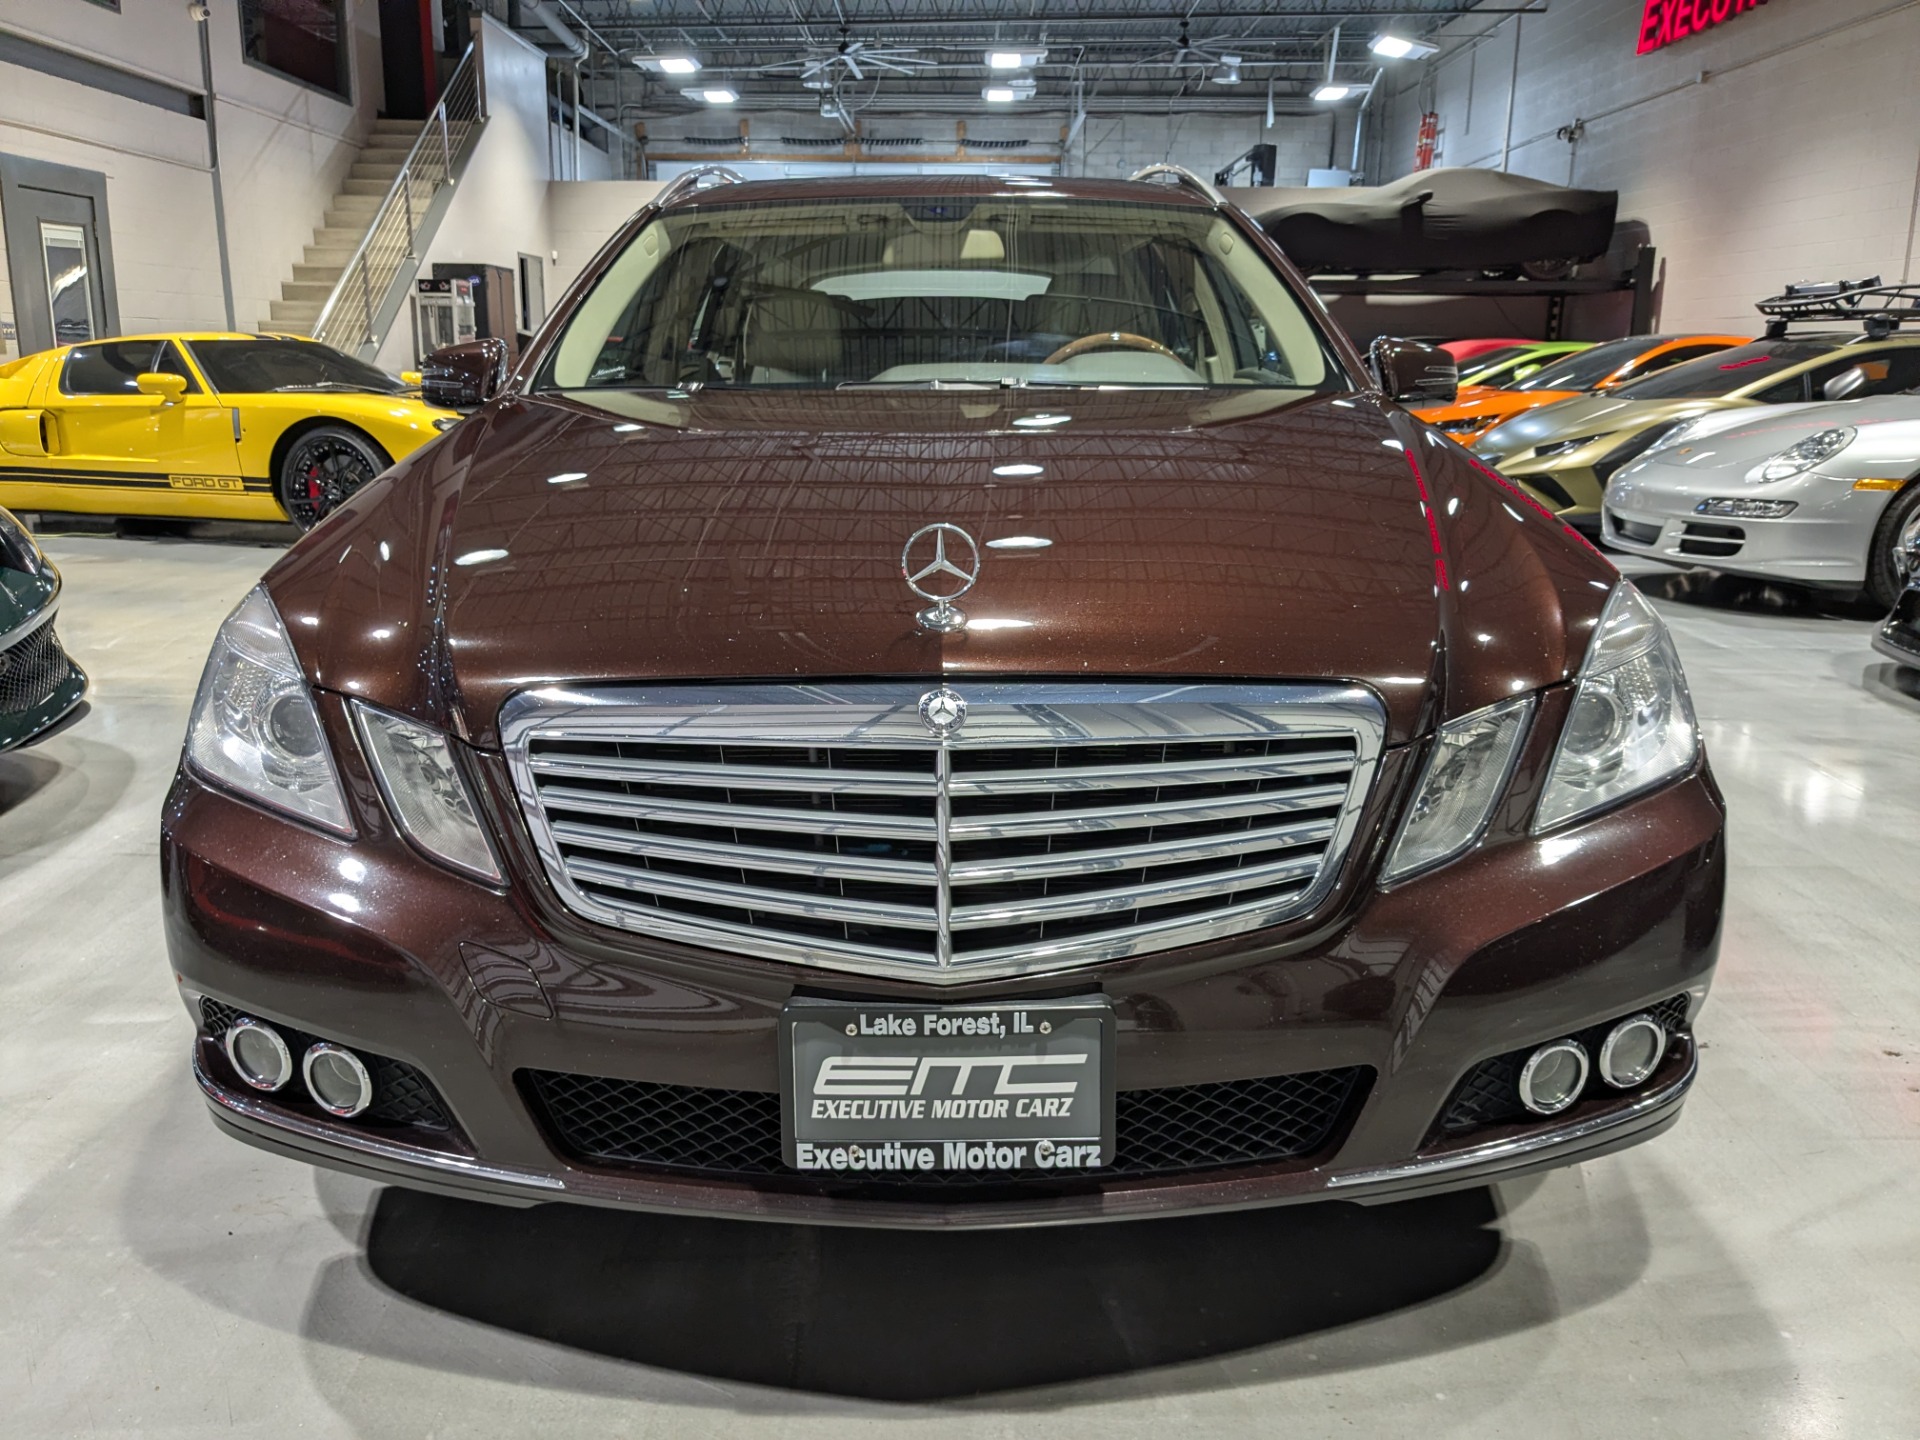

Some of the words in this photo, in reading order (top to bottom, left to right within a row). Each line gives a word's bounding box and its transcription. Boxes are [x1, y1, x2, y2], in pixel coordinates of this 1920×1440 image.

[1636, 0, 1758, 56] EXECU
[171, 476, 215, 488] FORD
[217, 478, 239, 489] GT
[860, 1013, 917, 1036] Lake
[923, 1013, 1006, 1038] Forest,
[1013, 1012, 1034, 1034] IL
[811, 1099, 926, 1119] EXECUTIVE
[931, 1098, 1009, 1119] MOTOR
[1015, 1097, 1074, 1118] CARZ
[796, 1142, 935, 1170] Executive
[943, 1141, 1027, 1170] Motor
[1034, 1141, 1101, 1169] Carz
